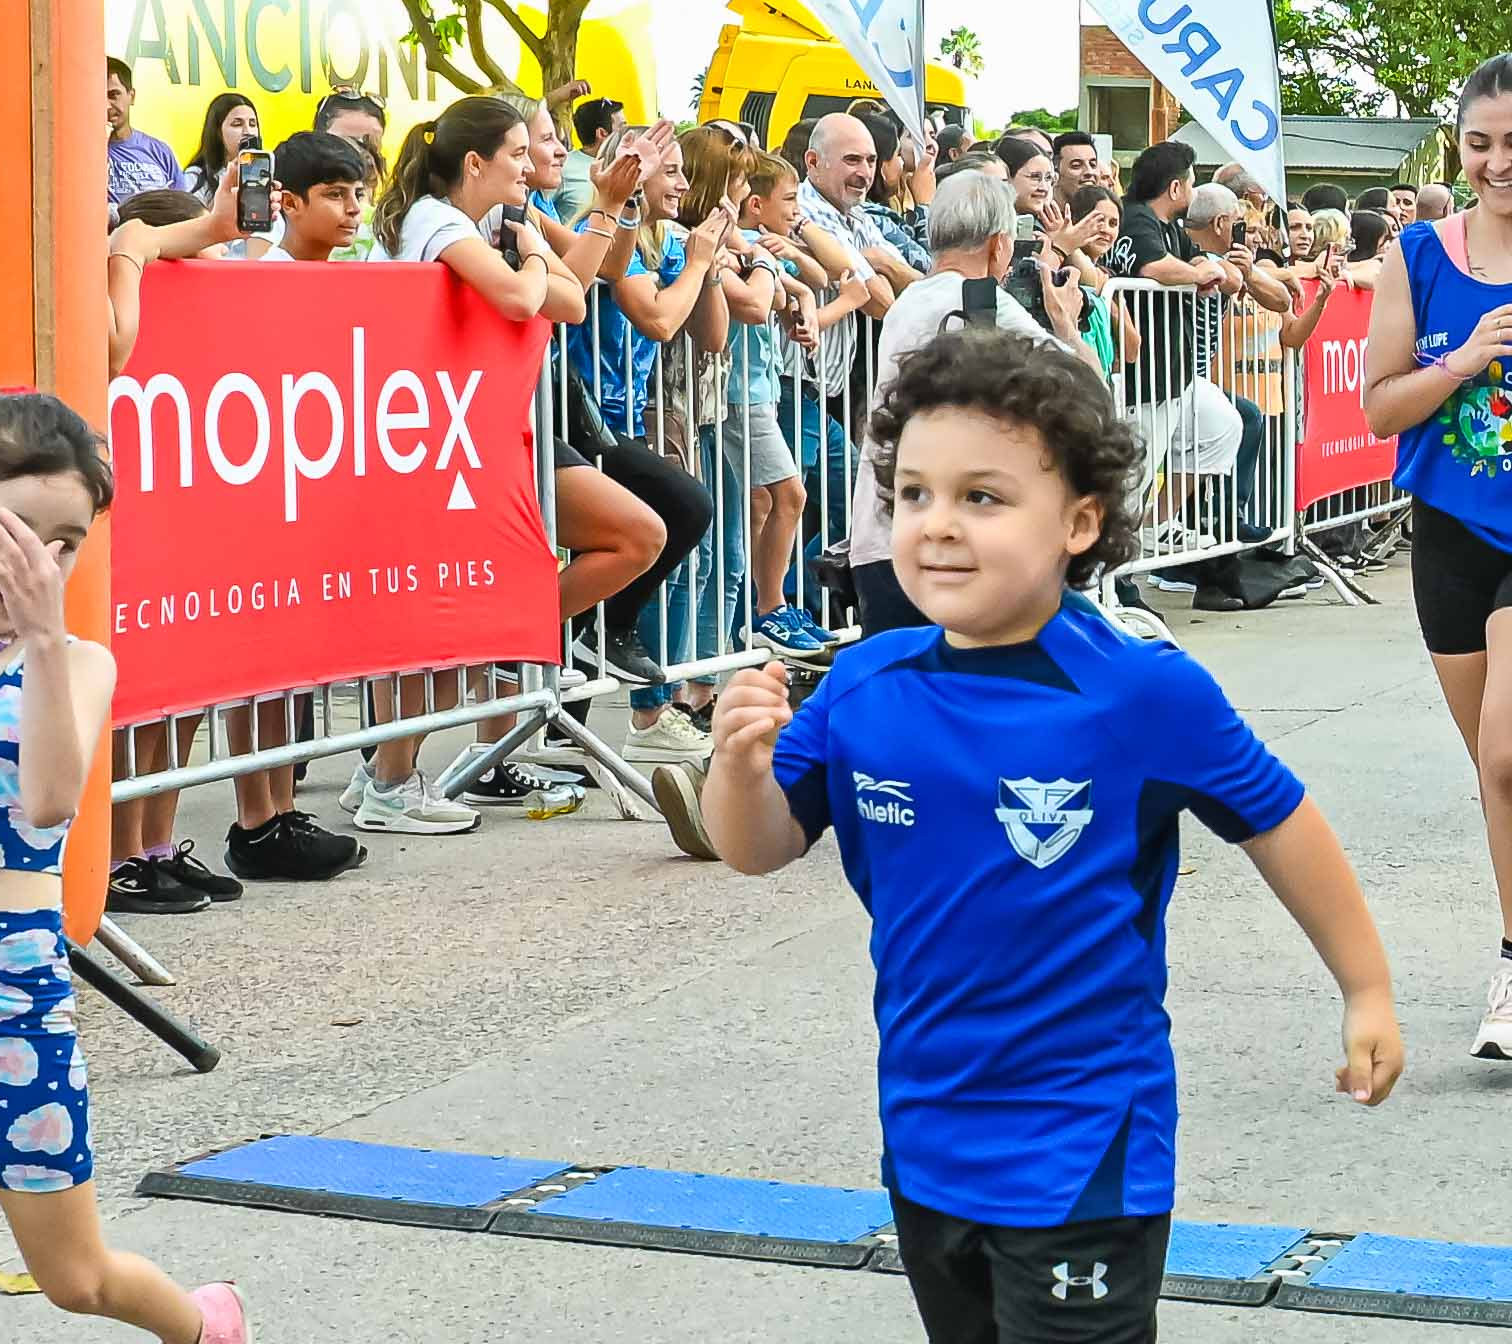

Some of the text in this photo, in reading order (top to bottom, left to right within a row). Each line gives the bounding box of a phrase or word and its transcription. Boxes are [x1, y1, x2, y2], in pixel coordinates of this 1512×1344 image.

[108, 327, 483, 522] moplex
[322, 572, 351, 601] EN
[368, 565, 418, 595] TUS
[438, 560, 495, 588] PIES
[761, 620, 790, 641] FILA
[1018, 813, 1069, 823] OLIVA
